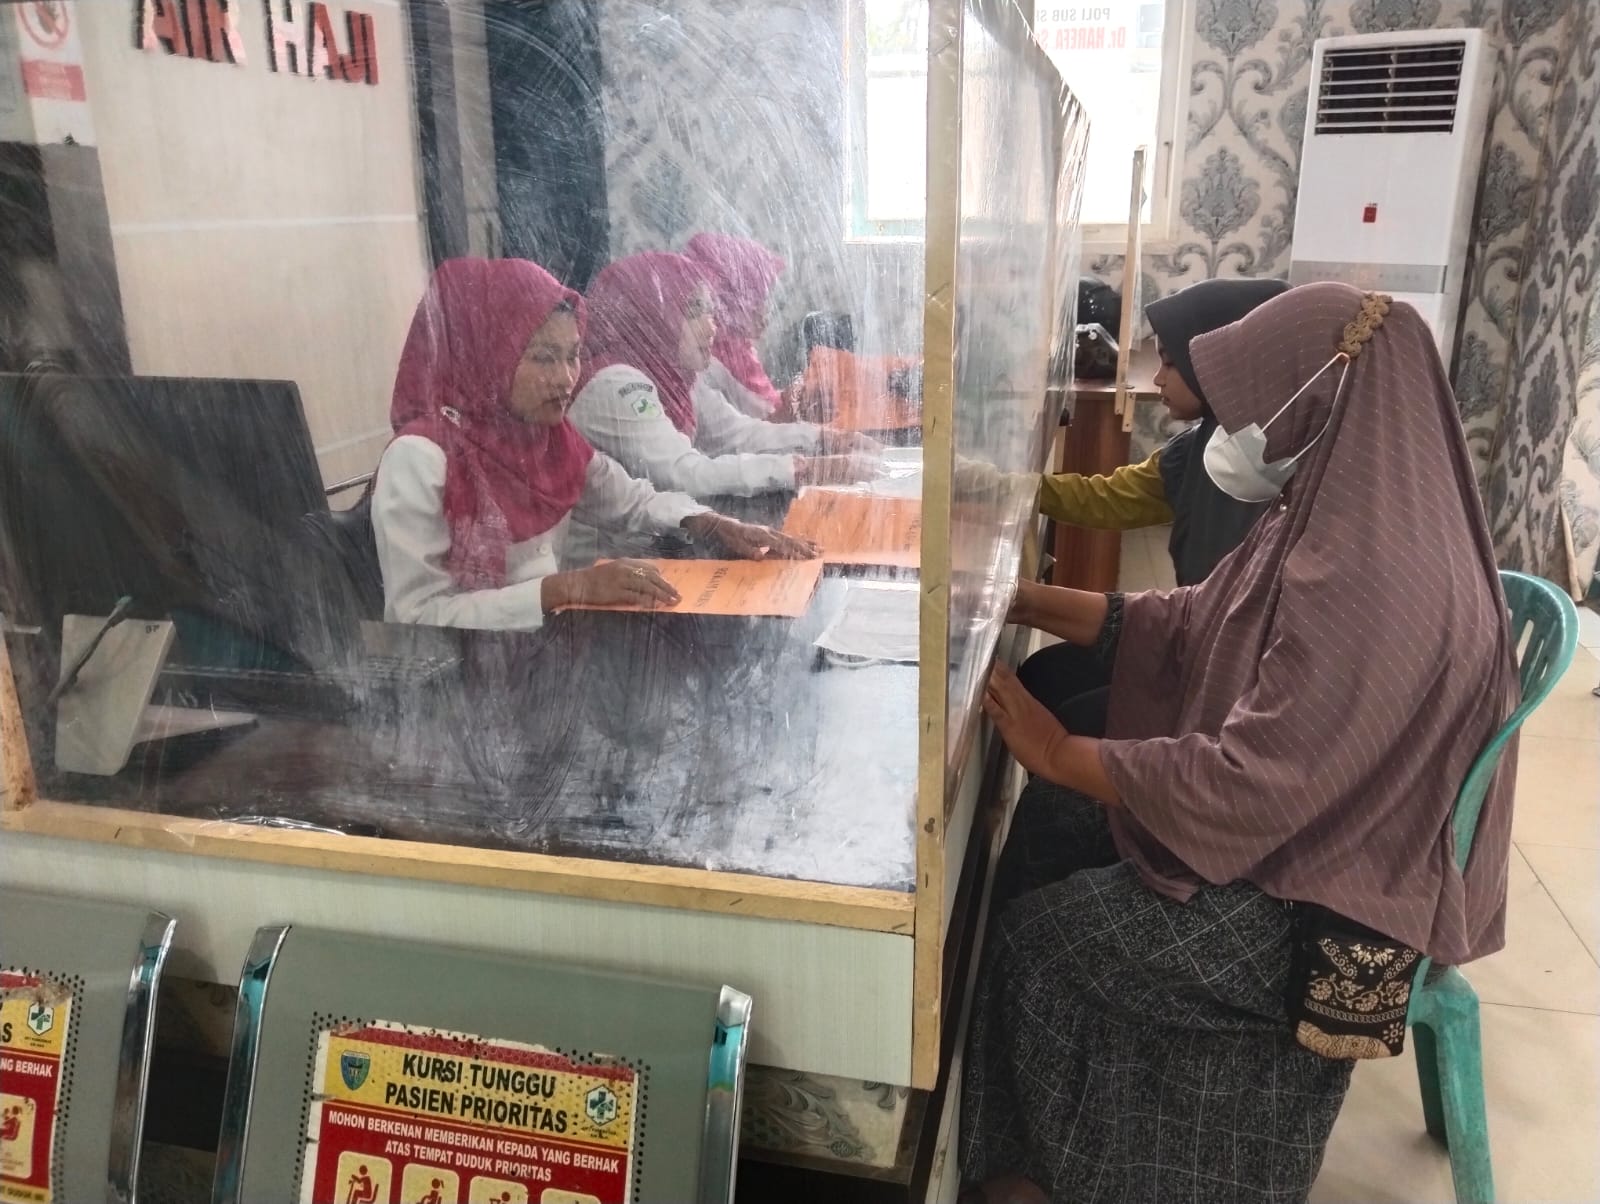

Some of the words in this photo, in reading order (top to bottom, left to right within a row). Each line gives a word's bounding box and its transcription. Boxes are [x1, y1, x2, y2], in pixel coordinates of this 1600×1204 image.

[137, 0, 247, 64] AIR
[265, 0, 379, 85] HAJI
[0, 1022, 13, 1043] S
[15, 1060, 53, 1077] BERHAK
[402, 1053, 463, 1083] KURSI
[470, 1064, 556, 1098] TUNGGU
[385, 1082, 455, 1114] PASIEN
[460, 1094, 568, 1133] PRIORITAS
[329, 1111, 365, 1129] MOHON
[368, 1118, 422, 1138] BERKENAN
[424, 1128, 494, 1152] MEMBERIKAN
[497, 1140, 538, 1159] KEPADA
[541, 1147, 571, 1165] YANG
[573, 1153, 620, 1173] BERHAK
[385, 1140, 411, 1157] ATAS
[413, 1145, 453, 1164] TEMPAT
[455, 1151, 493, 1172] DUDUK
[495, 1159, 552, 1182] PRIORITAS
